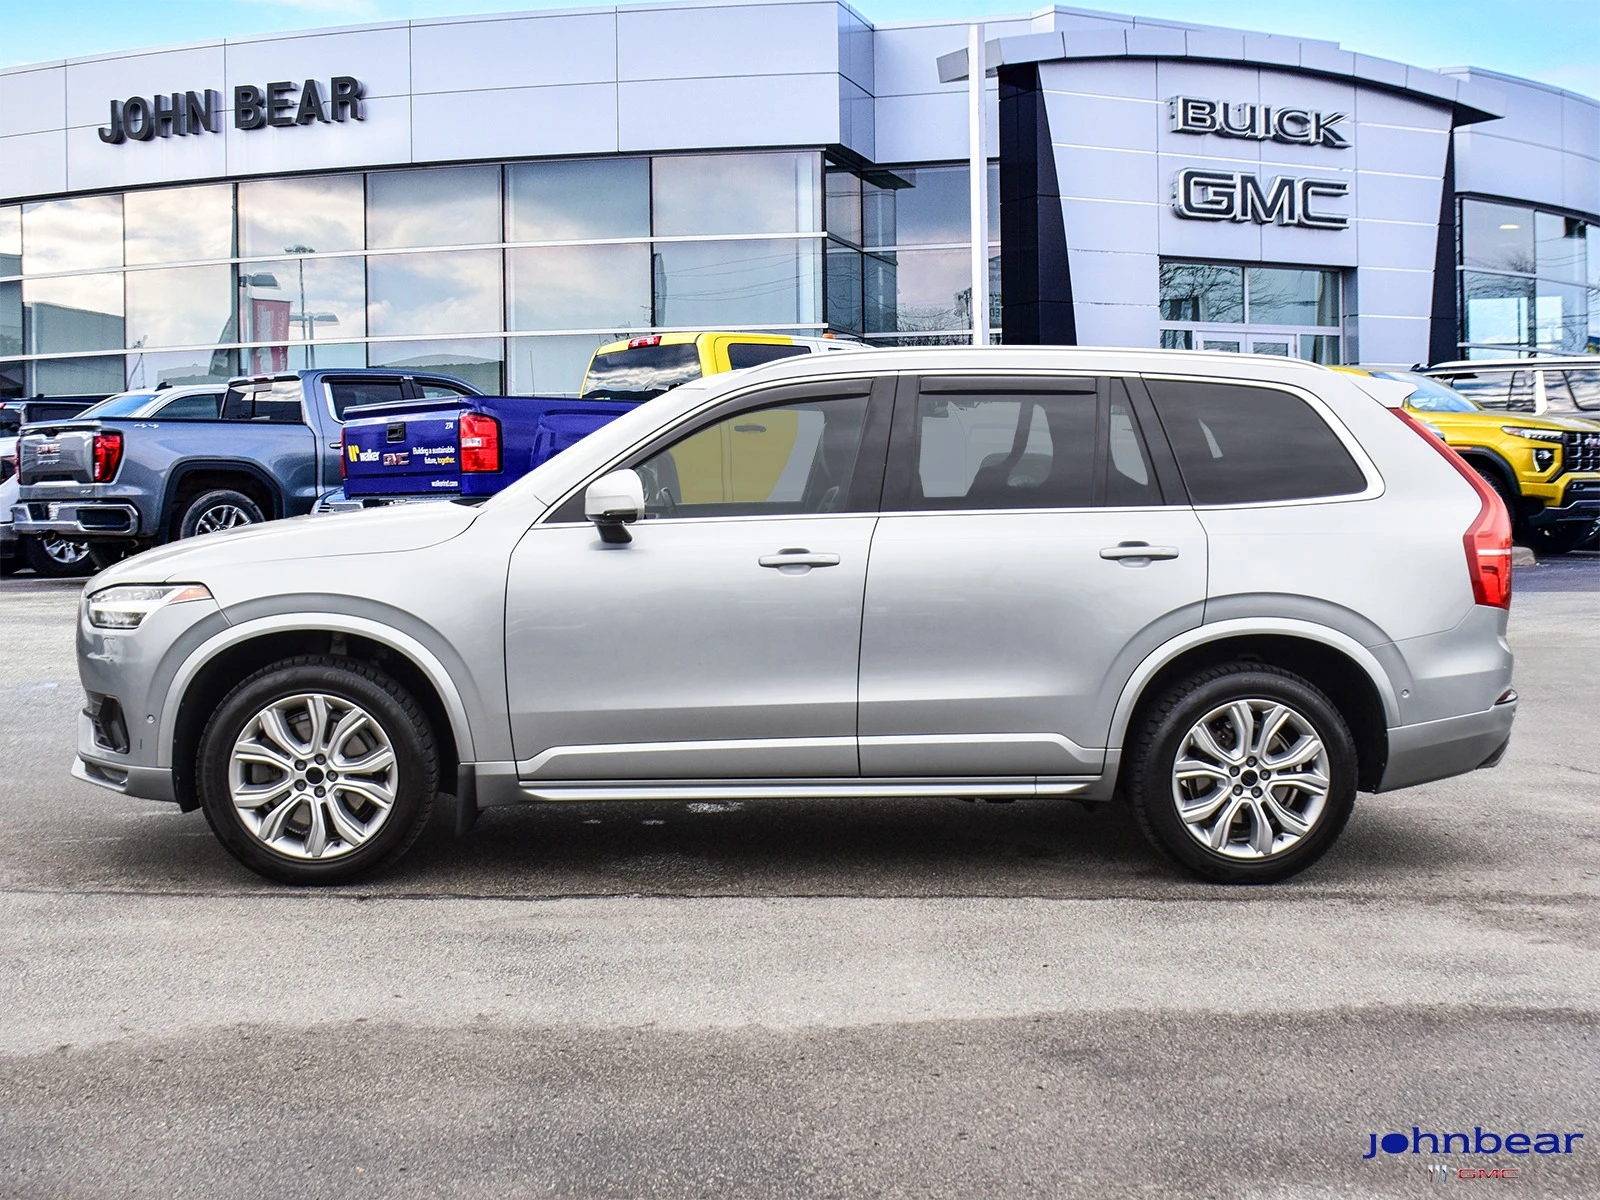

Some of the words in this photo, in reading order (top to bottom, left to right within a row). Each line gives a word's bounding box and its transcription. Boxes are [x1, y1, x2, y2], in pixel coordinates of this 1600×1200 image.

[98, 89, 219, 145] JOHN
[234, 76, 366, 130] BEAR
[1171, 95, 1352, 148] BUICK
[1174, 167, 1349, 230] GMC
[412, 447, 429, 456] Building
